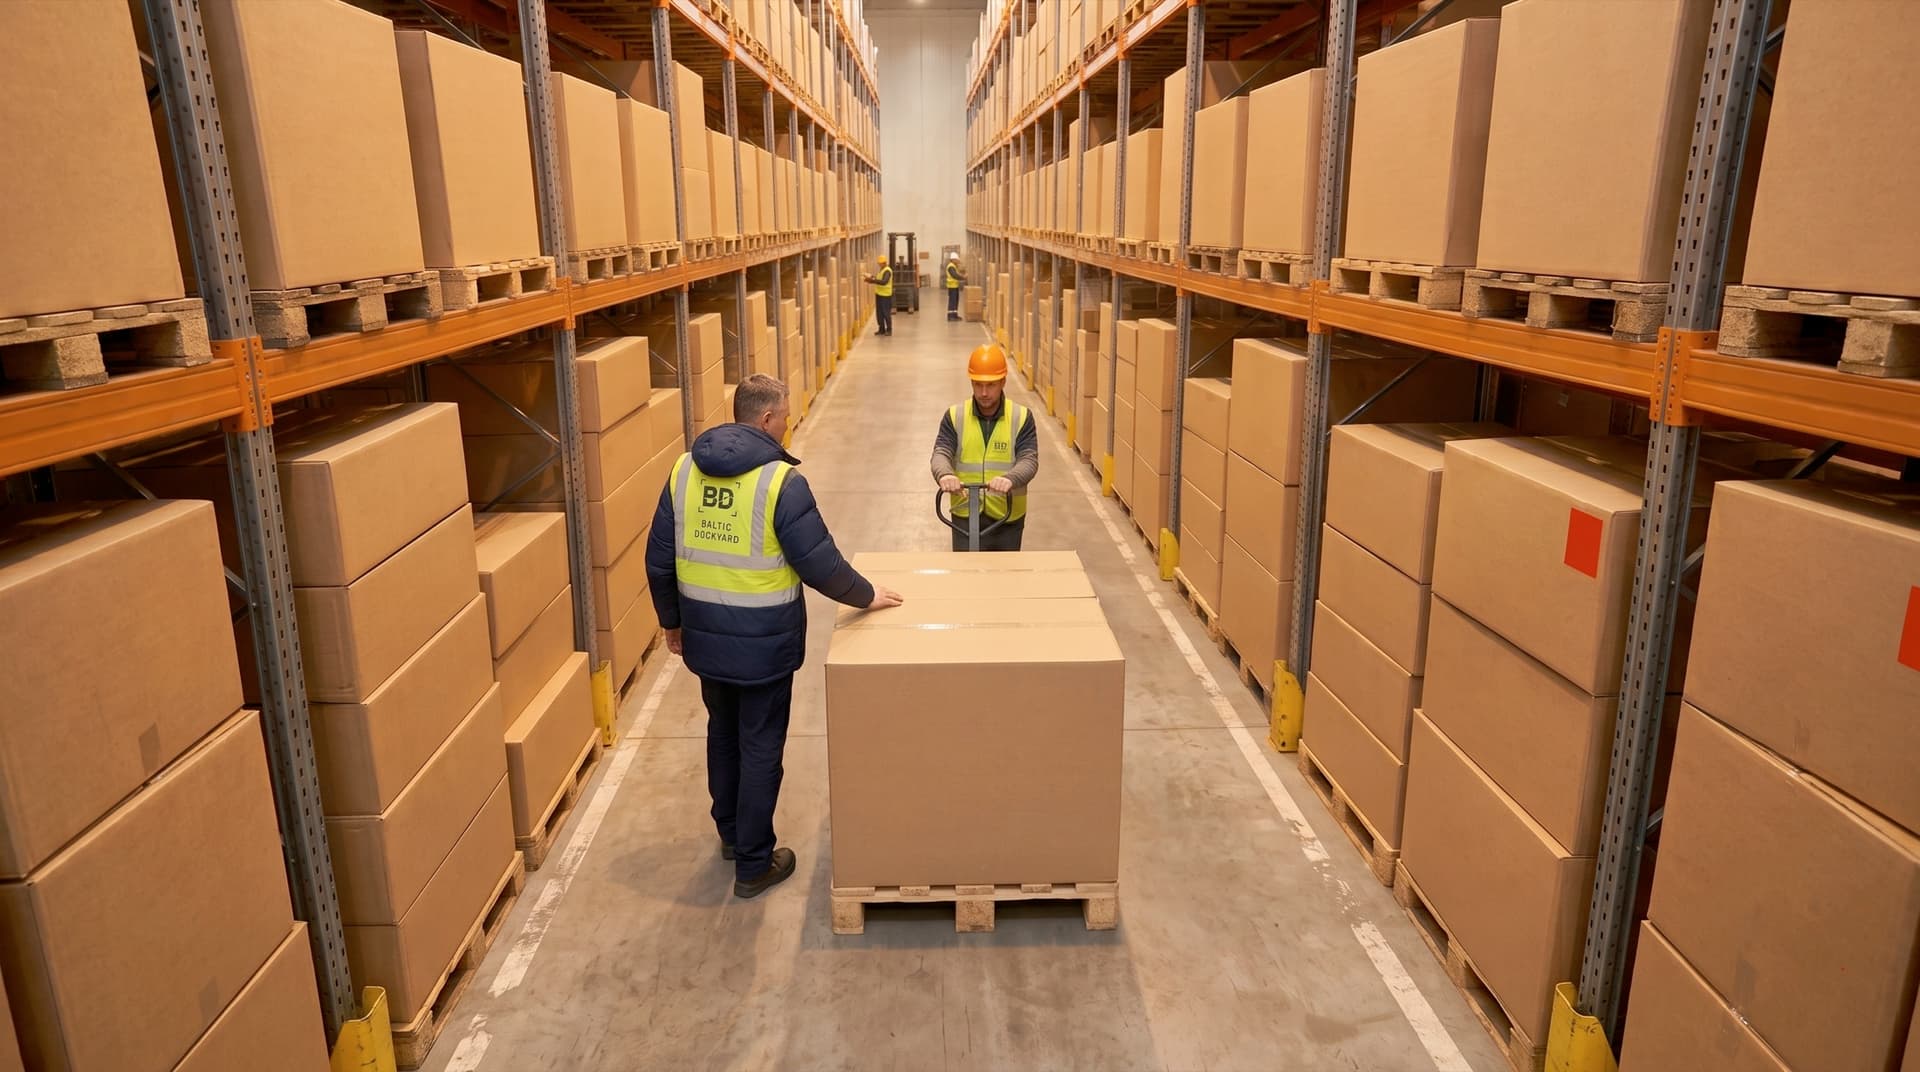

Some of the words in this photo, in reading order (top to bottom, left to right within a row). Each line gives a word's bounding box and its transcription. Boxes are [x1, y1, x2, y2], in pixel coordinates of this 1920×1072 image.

[702, 486, 734, 509] BD
[701, 520, 732, 531] BALTIC
[694, 530, 740, 543] DOCKYARD
